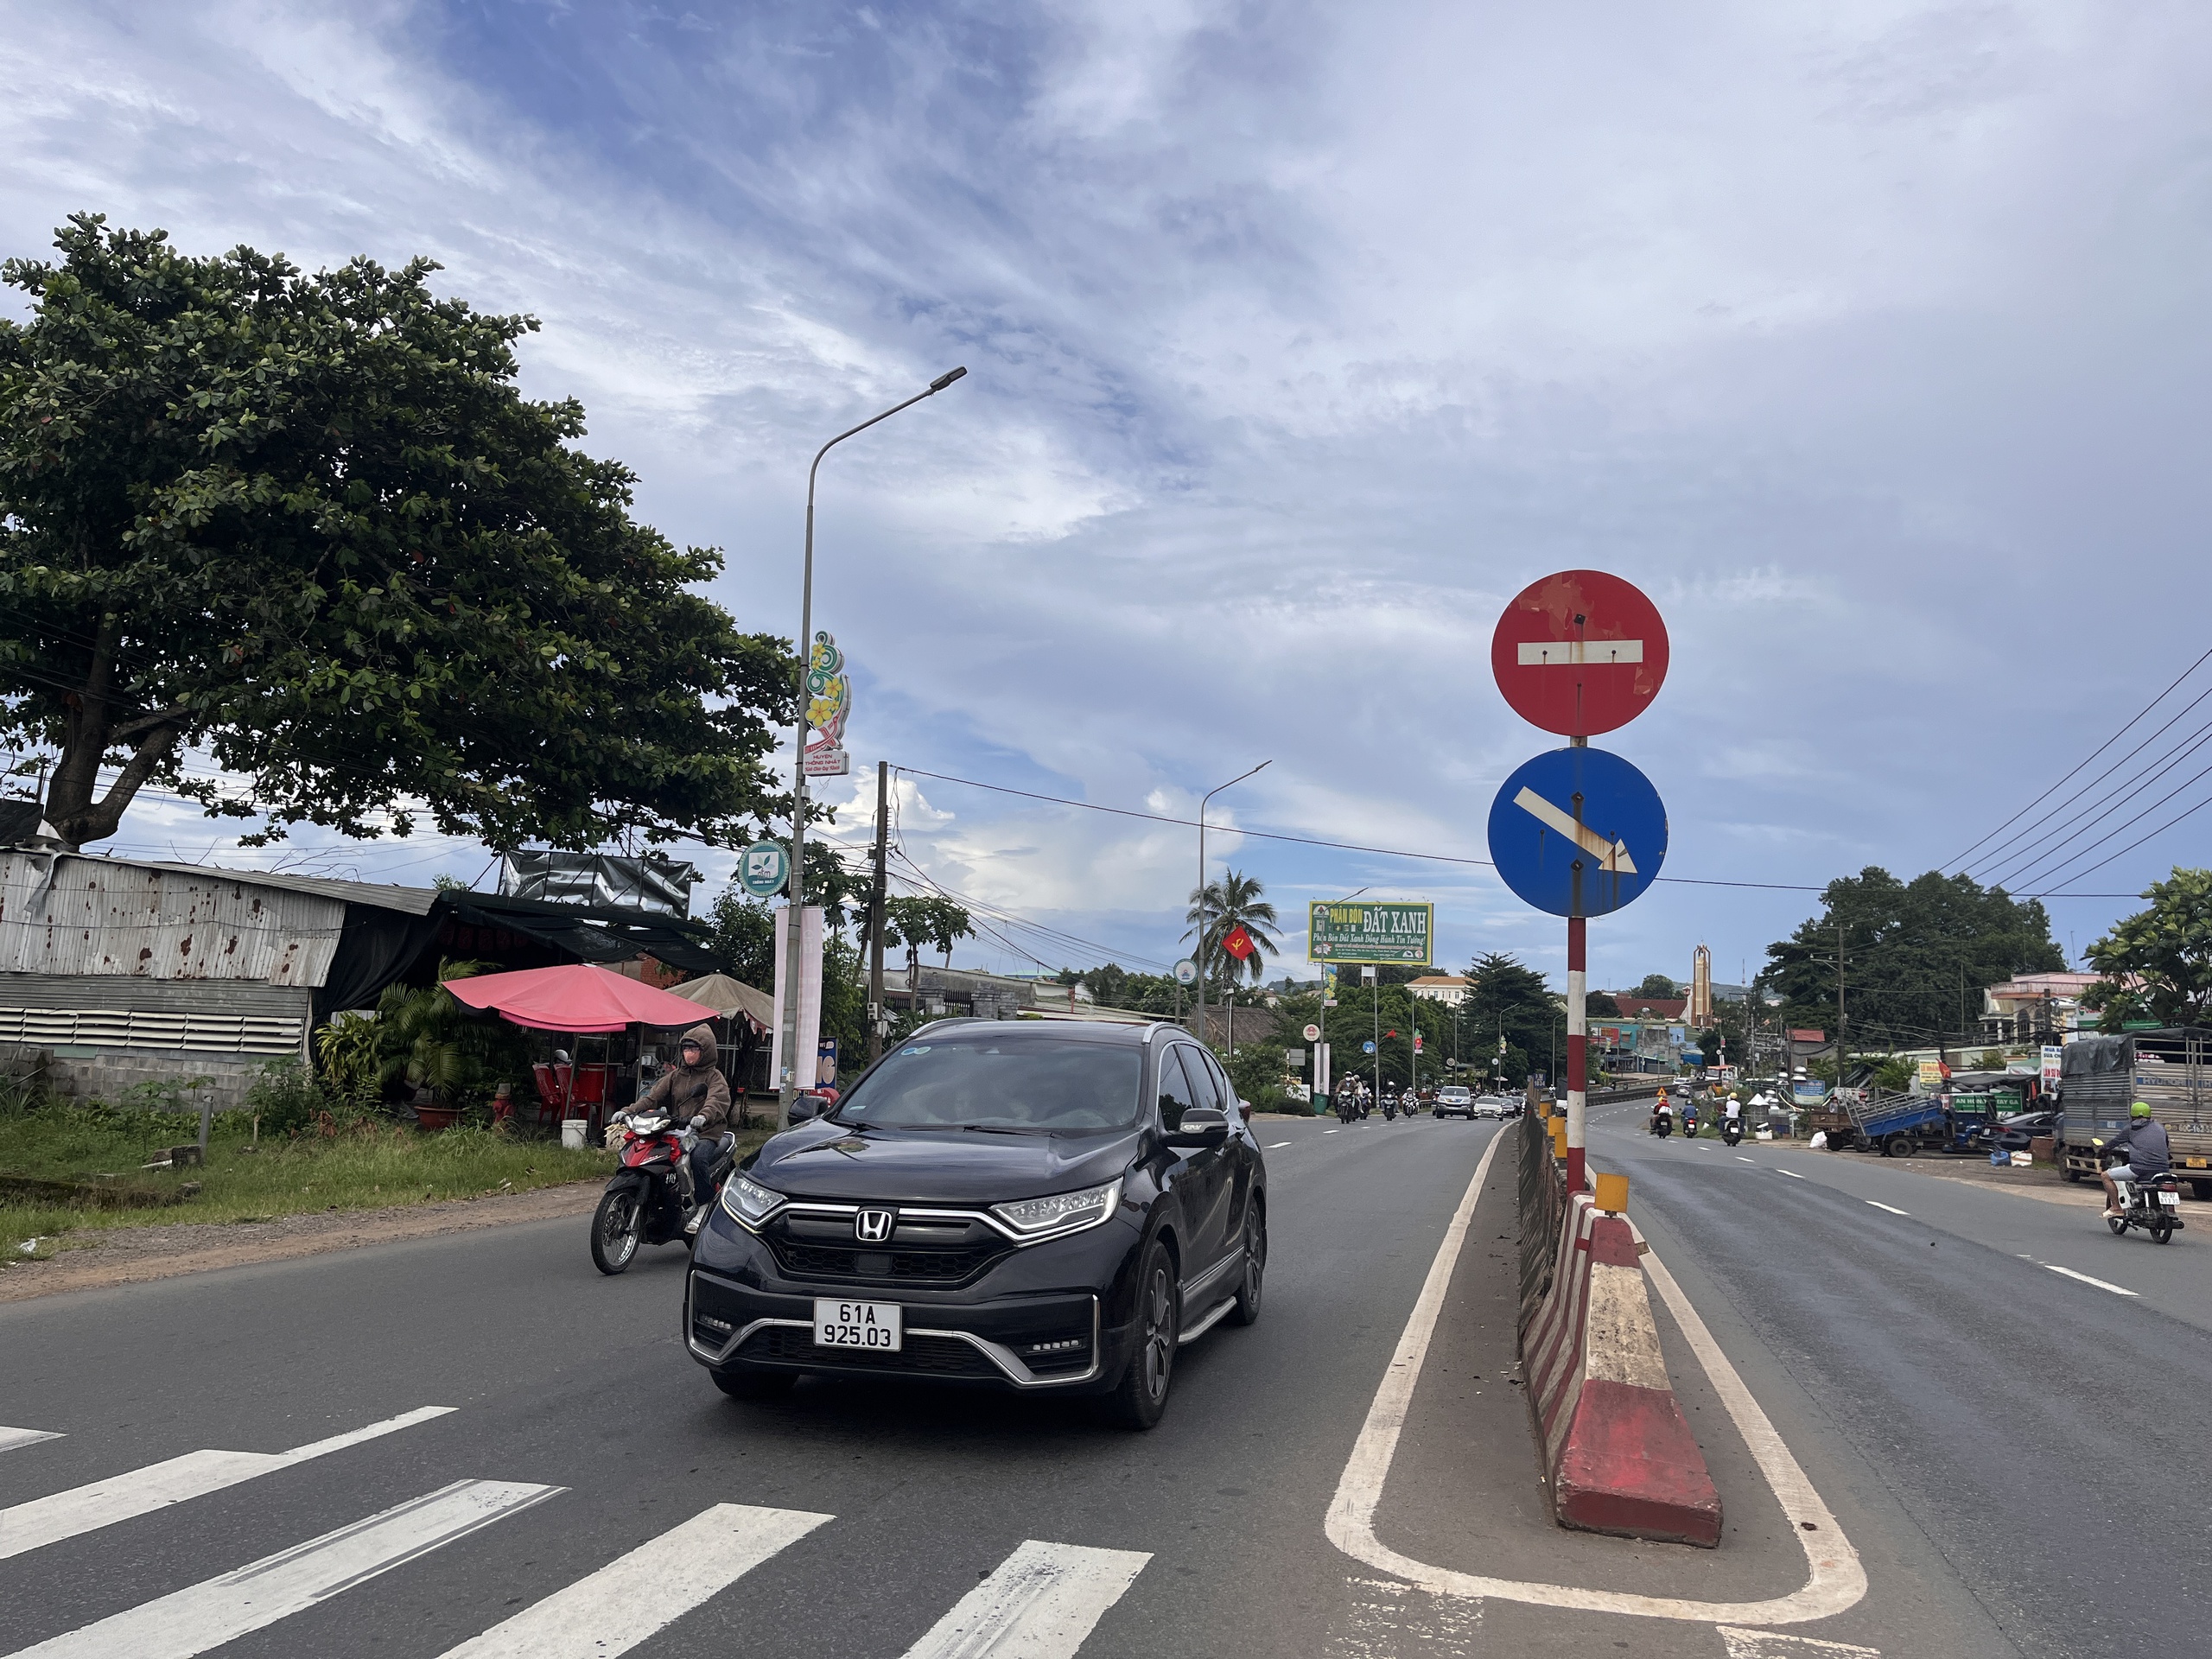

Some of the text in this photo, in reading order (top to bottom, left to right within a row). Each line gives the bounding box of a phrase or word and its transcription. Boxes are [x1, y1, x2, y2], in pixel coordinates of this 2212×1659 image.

[1330, 906, 1427, 934] PHÂN BÓN ĐẤT XANH
[1350, 934, 1364, 943] Xanh
[840, 1304, 876, 1325] 61A
[824, 1324, 891, 1347] 925.03
